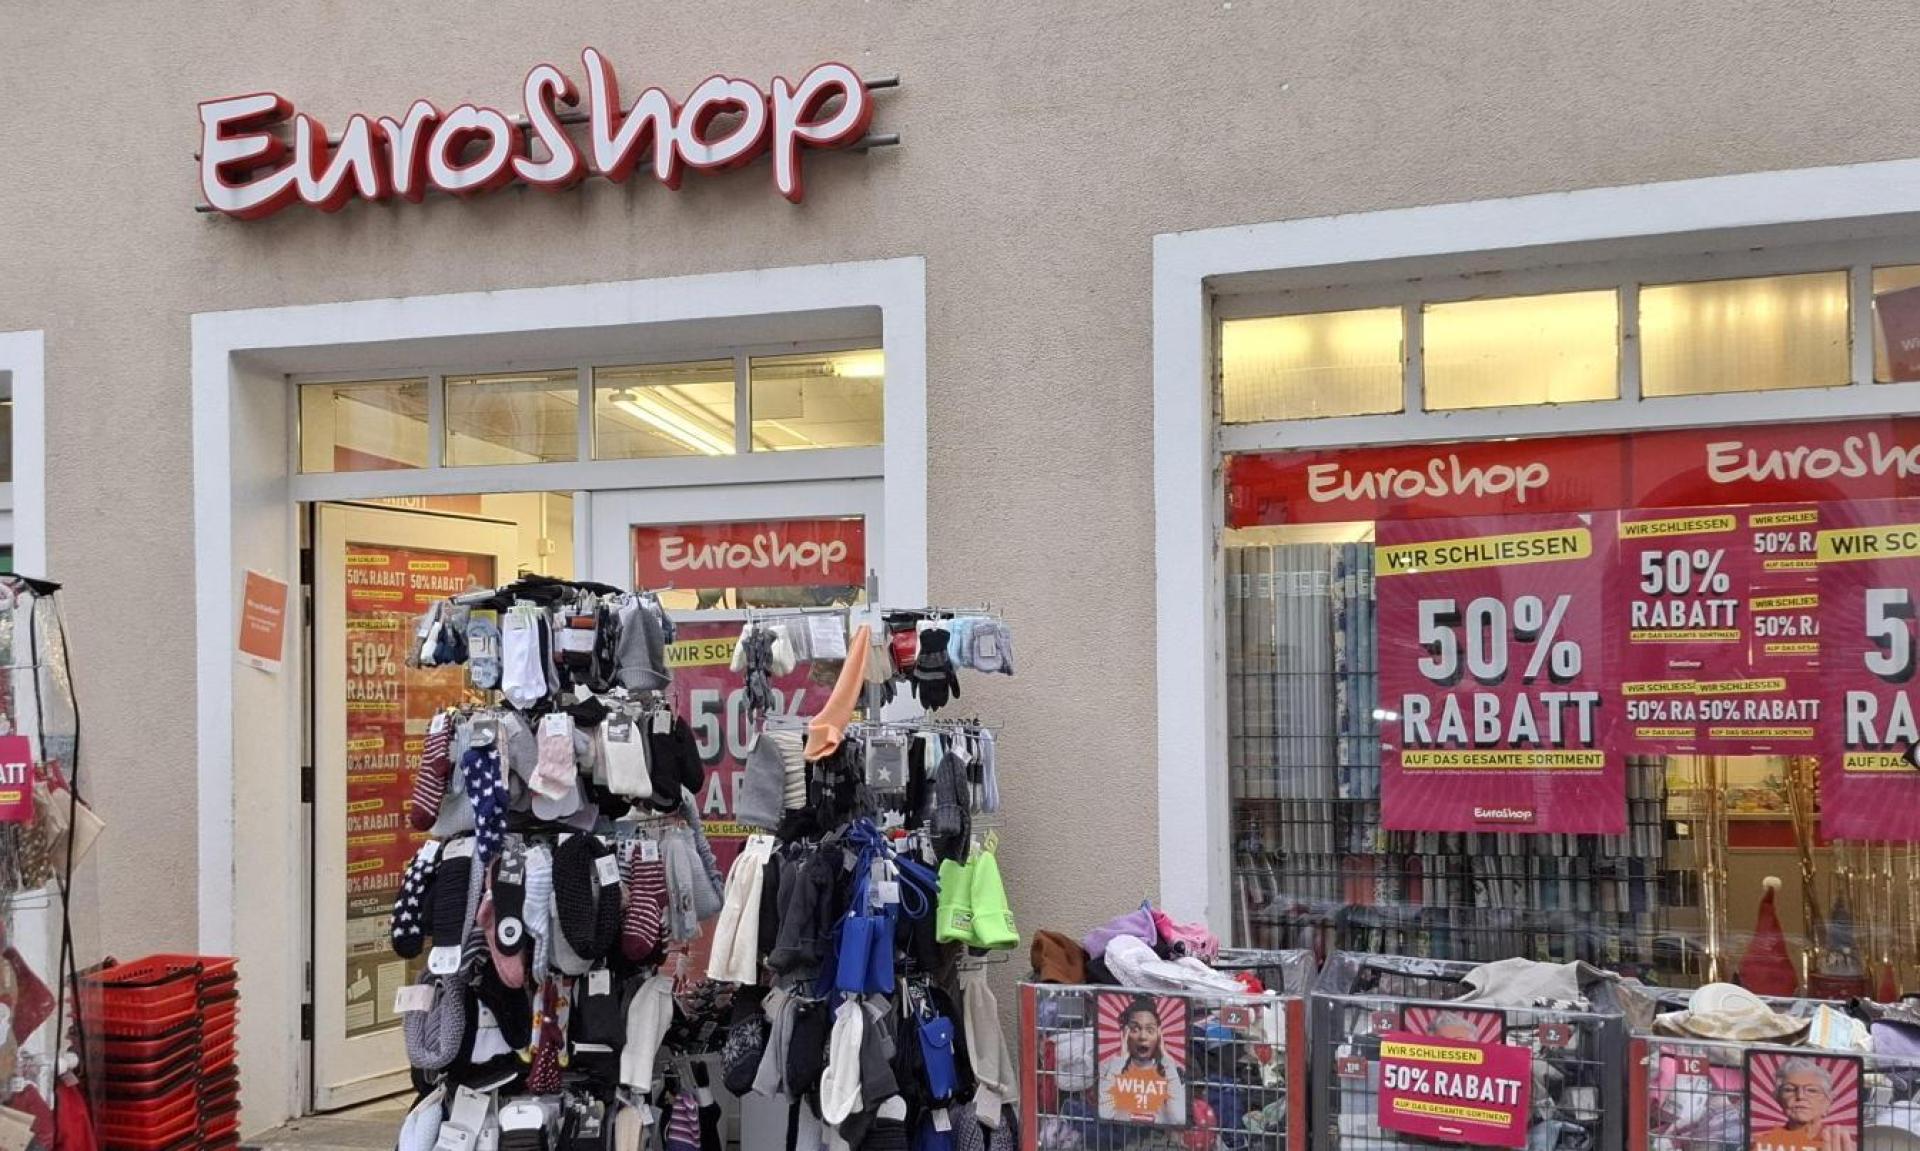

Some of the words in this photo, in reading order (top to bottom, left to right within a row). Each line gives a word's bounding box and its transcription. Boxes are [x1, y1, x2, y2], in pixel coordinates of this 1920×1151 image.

[1626, 524, 1648, 535] WIR
[1651, 518, 1729, 533] SCHLIESSEN
[1755, 516, 1773, 525] WIR
[1754, 532, 1796, 553] 50%
[1831, 535, 1878, 555] WIR
[1885, 532, 1918, 551] SC
[1387, 550, 1428, 570] WIR
[1435, 535, 1578, 565] SCHLIESSEN
[347, 569, 369, 586] 50%
[370, 571, 406, 588] RABATT
[1640, 549, 1731, 595] 50%
[410, 574, 430, 590] 50%
[431, 576, 464, 592] RABATT
[1755, 600, 1774, 609] WIR
[1631, 600, 1739, 628] RABATT
[1755, 616, 1796, 636] 50%
[1417, 594, 1583, 683] 50%
[352, 642, 396, 676] 50%
[667, 645, 699, 662] WIR
[348, 680, 400, 700] RABATT
[1720, 681, 1781, 691] SCHLIESSEN
[1402, 691, 1600, 746] RABATT
[1627, 700, 1667, 721] 50%
[1700, 700, 1740, 721] 50%
[1745, 700, 1820, 720] RABATT
[364, 754, 400, 769] RABATT
[1404, 754, 1430, 765] AUF
[1433, 754, 1458, 765] DAS
[1463, 754, 1523, 765] GESAMTE
[1527, 753, 1602, 765] SORTIMENT
[1846, 757, 1876, 767] AUF
[1880, 756, 1908, 767] DAS
[363, 812, 400, 829] RABATT
[363, 873, 400, 890] RABATT
[1387, 1045, 1410, 1056] WIR
[1410, 1047, 1477, 1062] SCHLIESSEN
[1682, 1058, 1701, 1073] 1€
[1116, 1077, 1167, 1094] WHAT
[1384, 1063, 1430, 1094] 50%
[1434, 1070, 1522, 1105] RABATT
[1136, 1094, 1149, 1109] ?!
